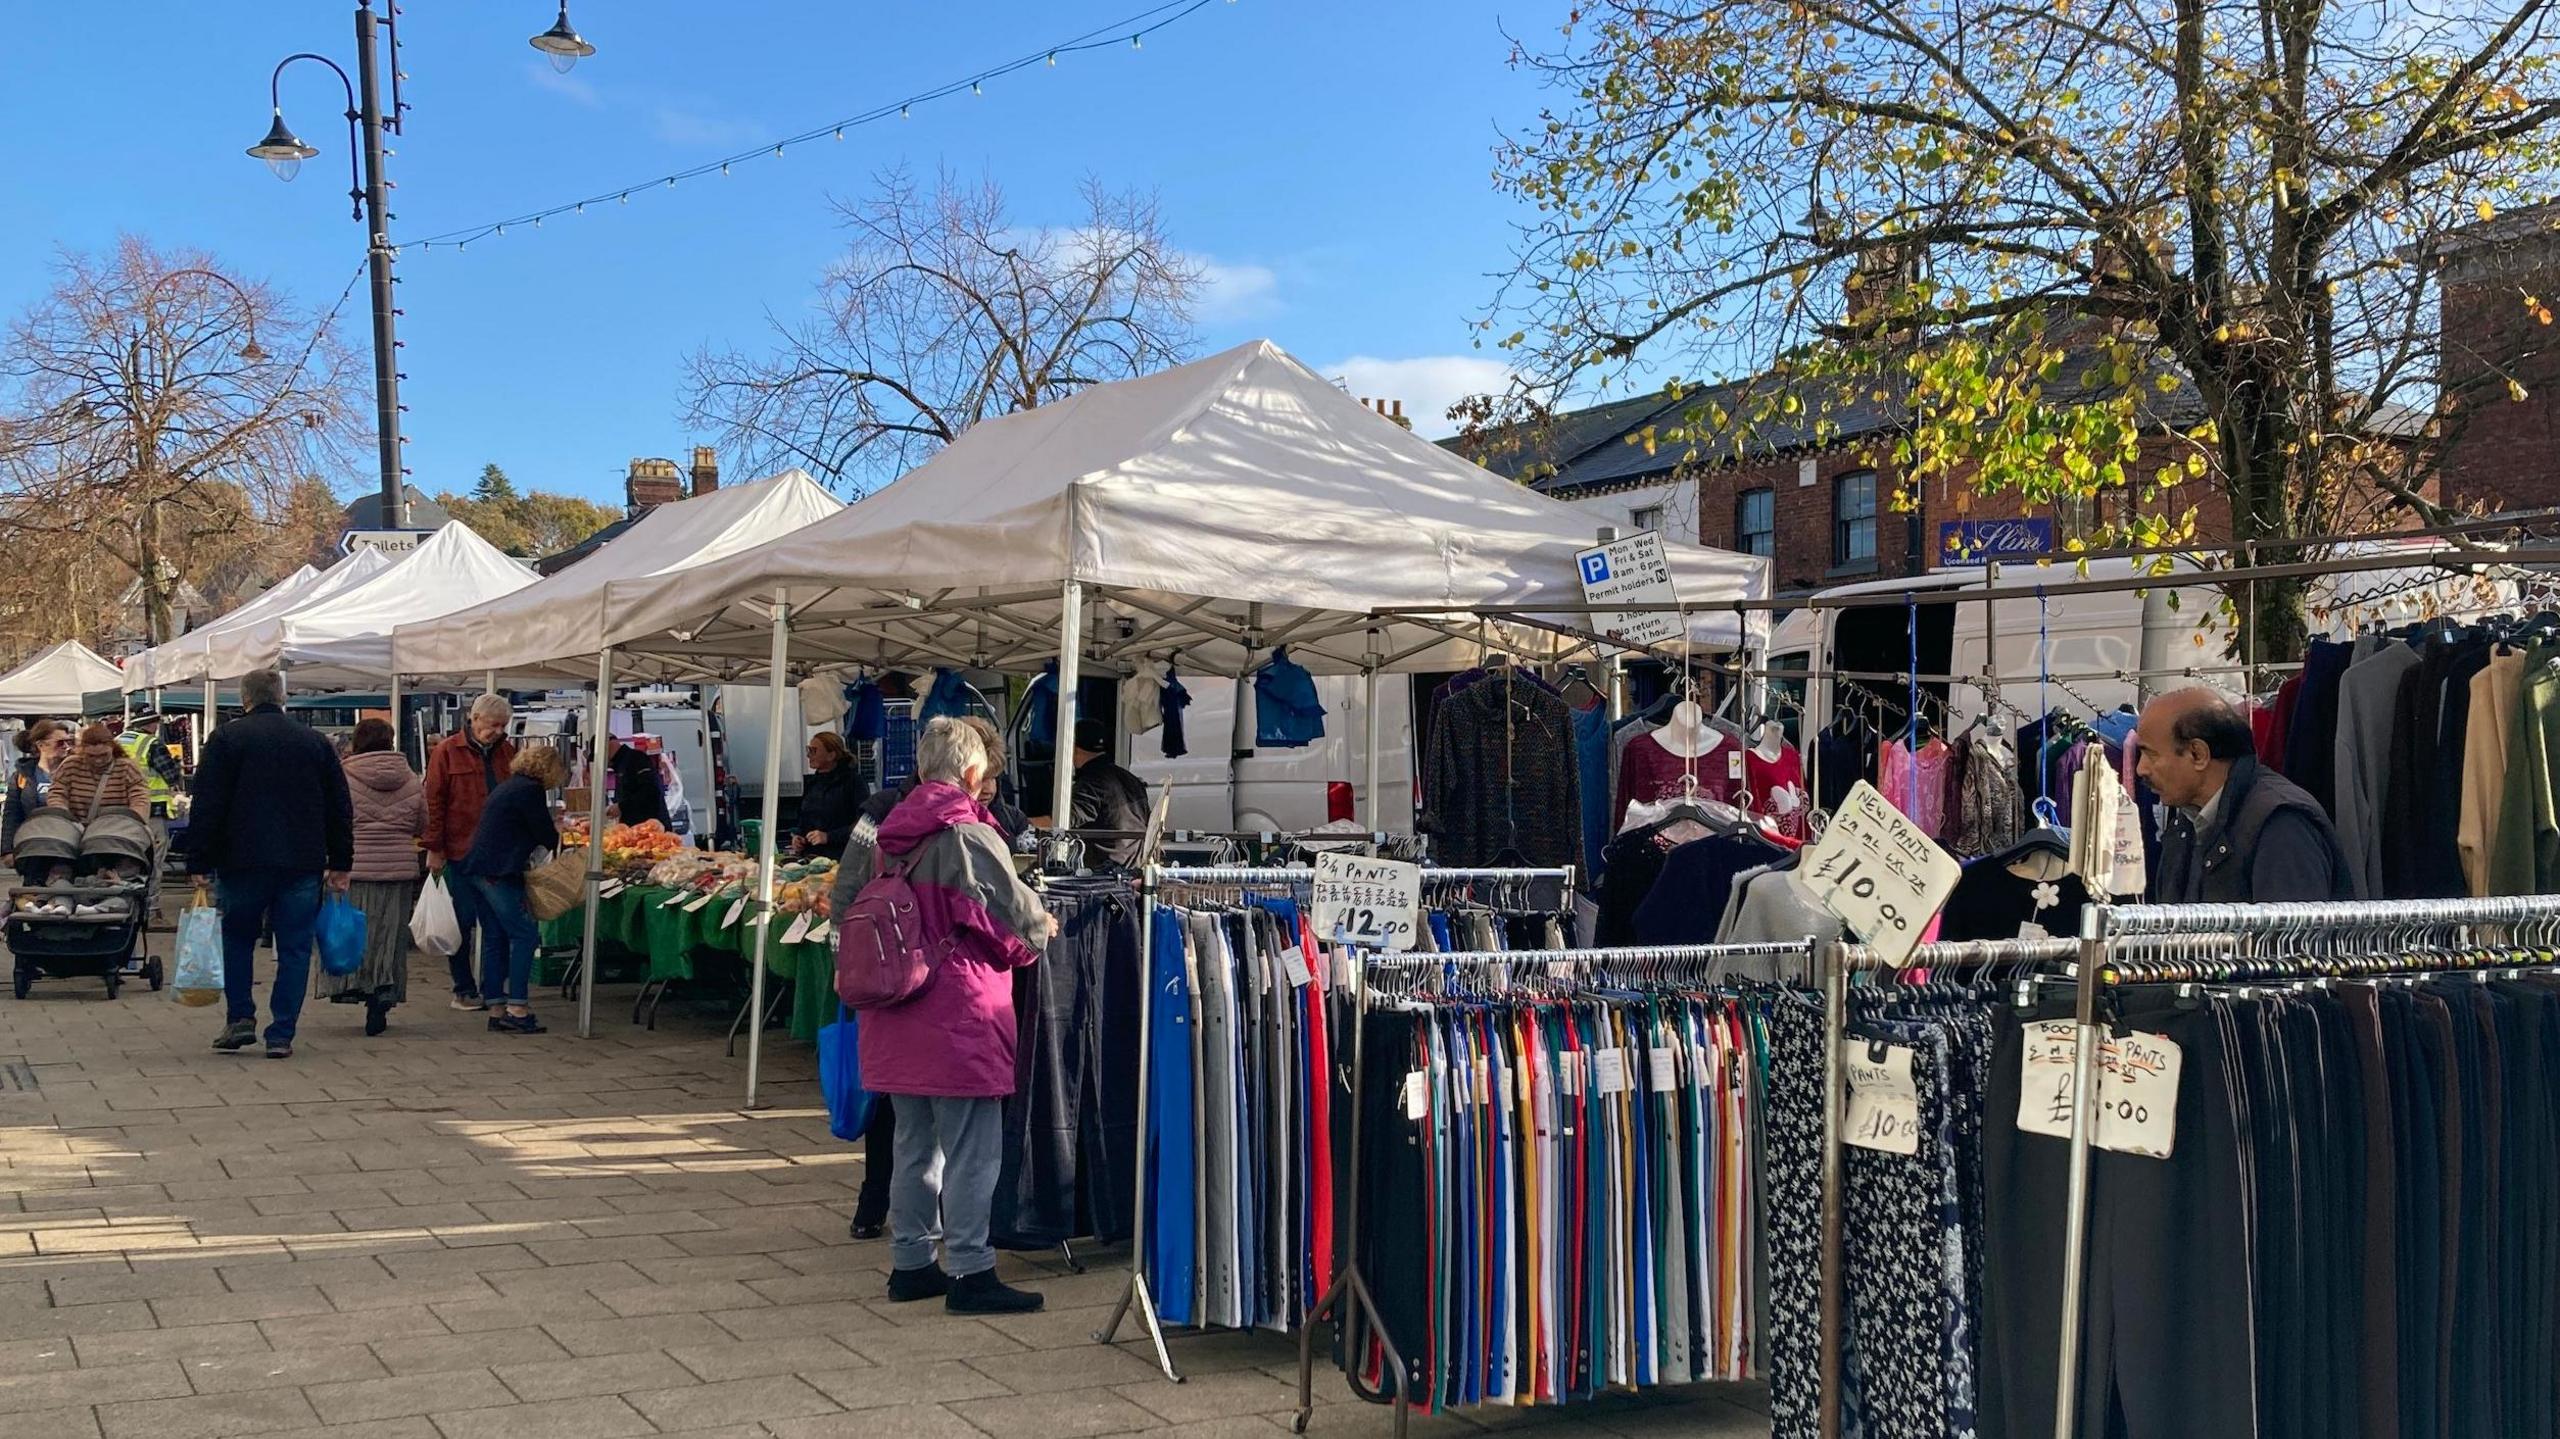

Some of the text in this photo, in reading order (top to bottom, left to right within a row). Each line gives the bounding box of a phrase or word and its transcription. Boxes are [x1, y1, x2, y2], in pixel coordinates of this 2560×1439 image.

[1608, 545, 1628, 557] Mon
[1634, 536, 1654, 549] Wed
[1614, 548, 1654, 567] Fri & Sat
[1587, 556, 1604, 581] P
[1589, 585, 1620, 601] Permit
[1621, 575, 1655, 592] holders
[1617, 613, 1625, 622] 2
[1632, 617, 1661, 632] return
[1642, 632, 1647, 640] 1
[1857, 791, 1930, 863] NEW PANTS
[1346, 862, 1398, 880] PANTS
[1813, 849, 1907, 931] £10.00
[1333, 907, 1409, 936] £12.00
[2126, 1041, 2166, 1070] PANTS
[1850, 1063, 1890, 1082] PANTS
